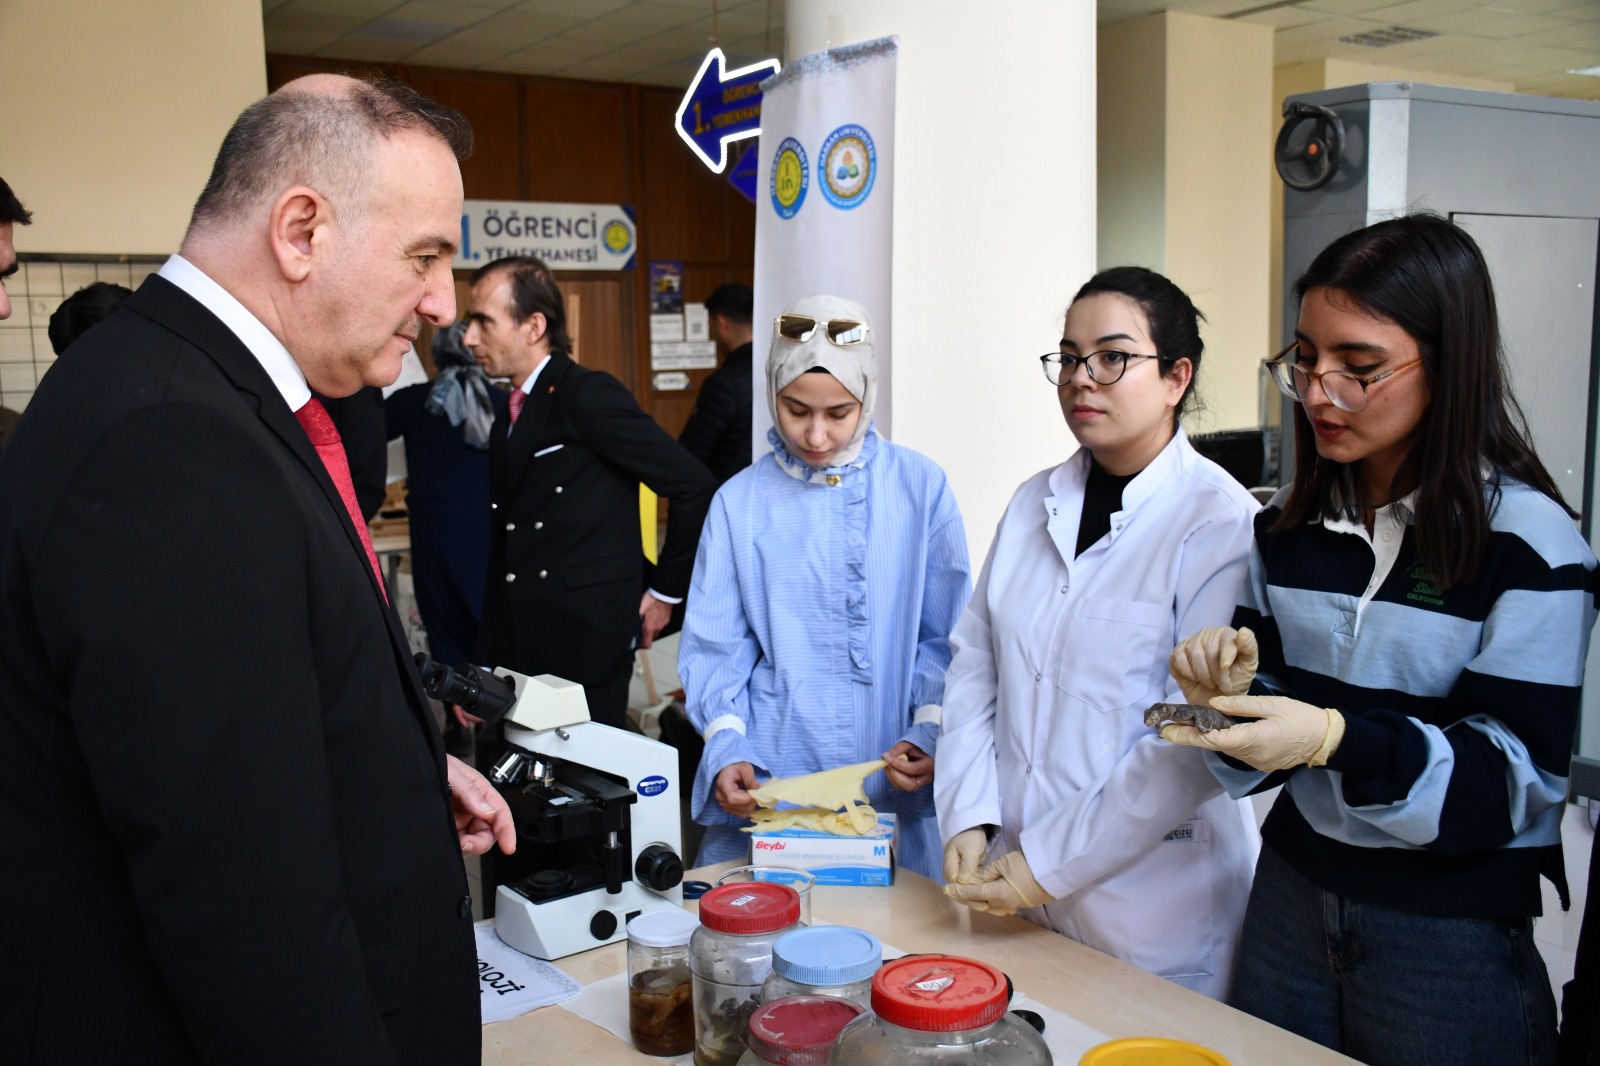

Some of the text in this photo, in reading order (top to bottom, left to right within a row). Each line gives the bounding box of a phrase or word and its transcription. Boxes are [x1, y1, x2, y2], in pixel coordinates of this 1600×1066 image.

[483, 209, 597, 240] ÖĞRENCİ
[755, 840, 886, 857] Beybi M
